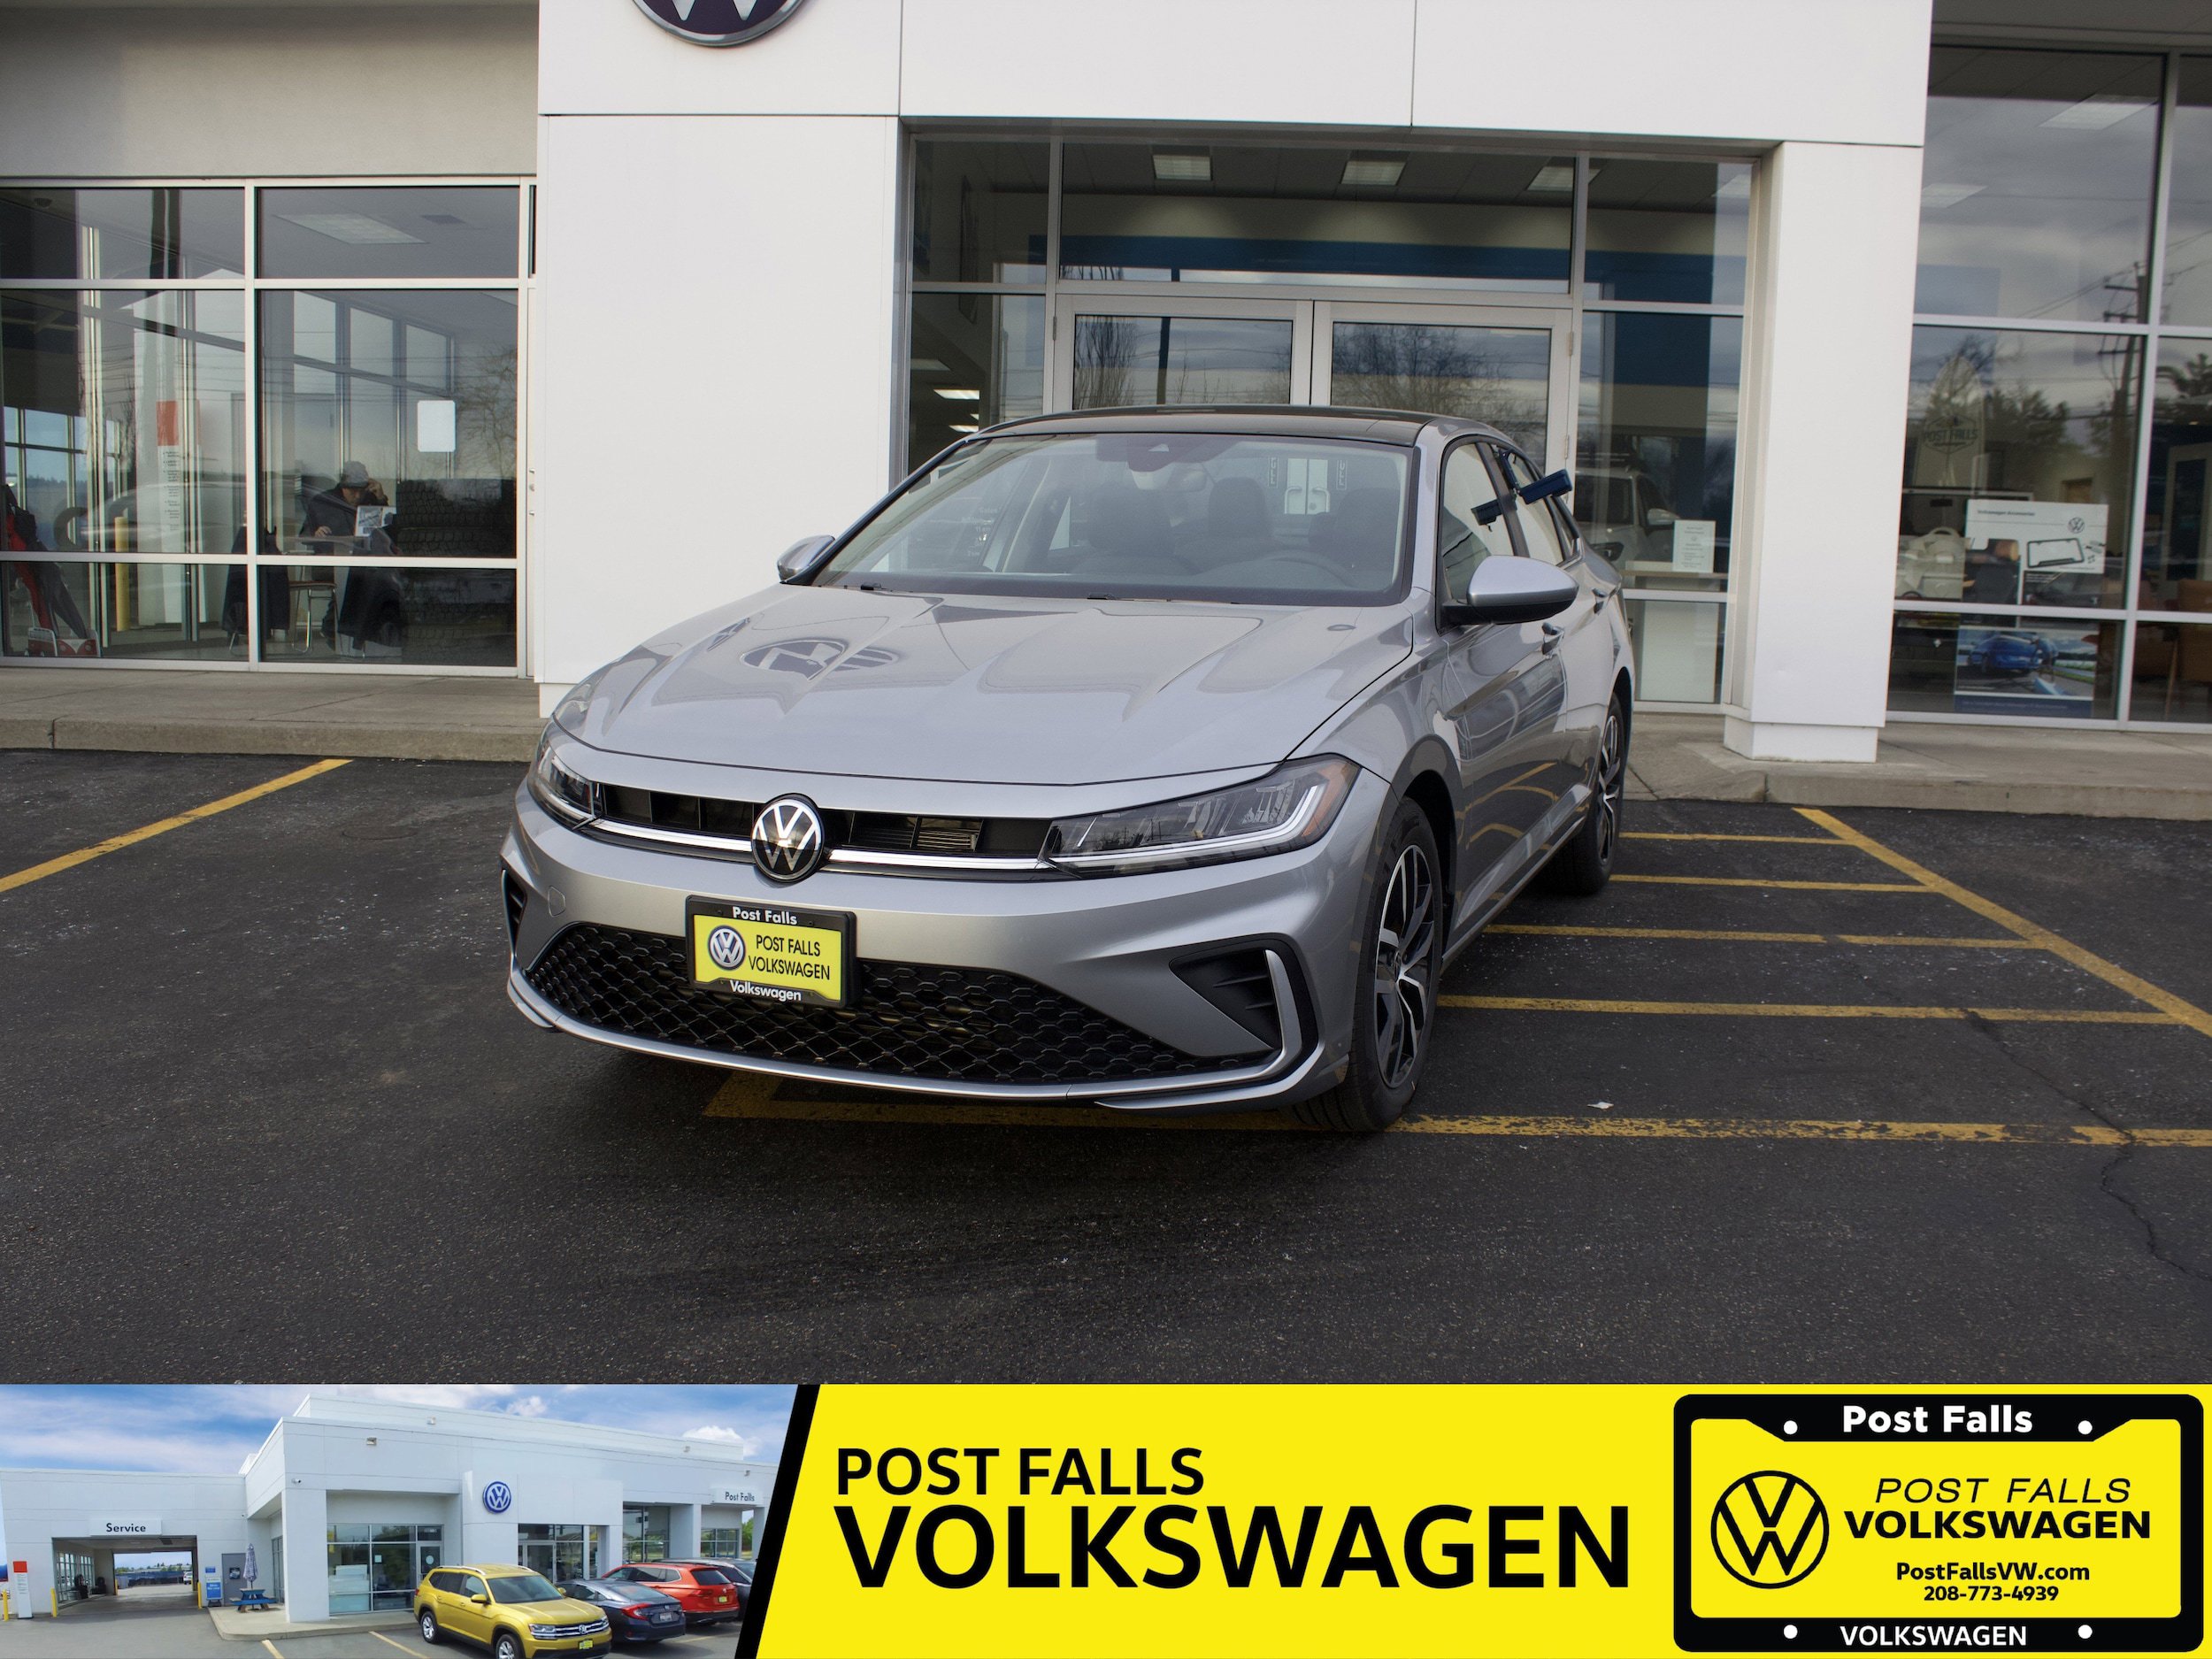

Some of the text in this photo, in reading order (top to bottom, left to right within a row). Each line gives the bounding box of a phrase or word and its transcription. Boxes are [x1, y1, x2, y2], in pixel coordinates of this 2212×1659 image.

[732, 906, 797, 926] Post Falls
[756, 934, 821, 956] POST FALLS
[749, 955, 830, 980] VOLKSWAGEN
[730, 979, 802, 1002] Volkswagen
